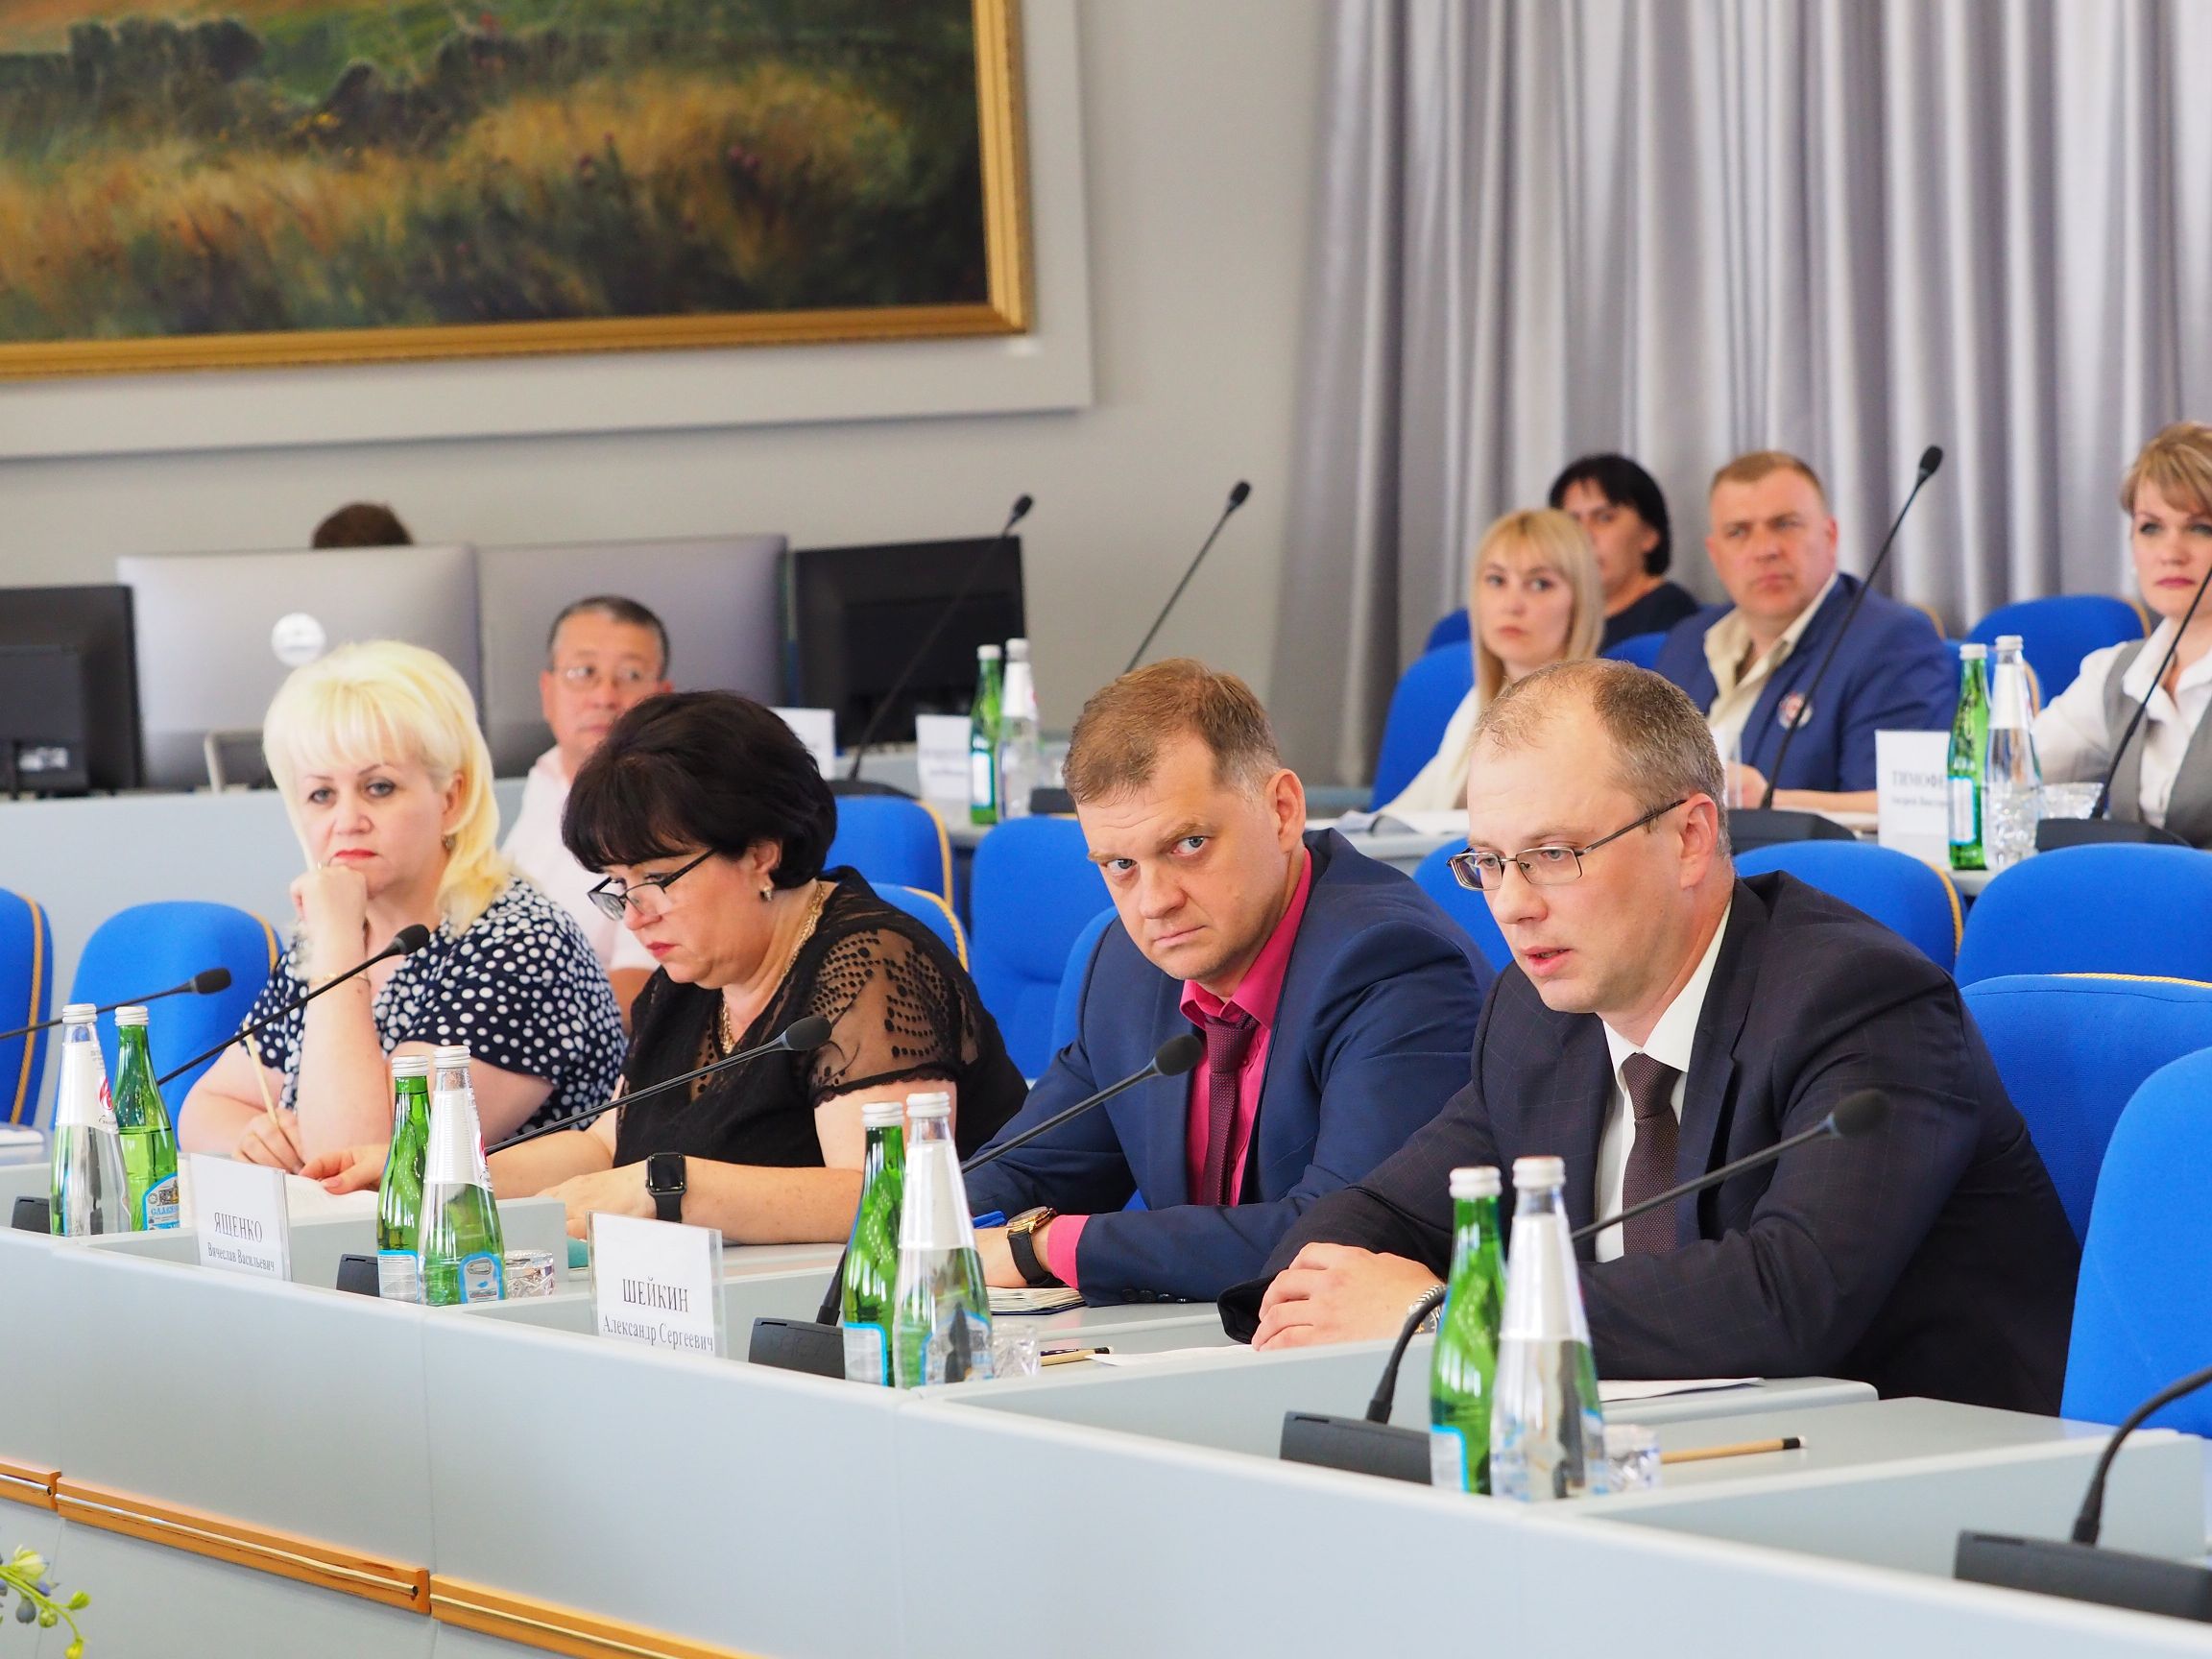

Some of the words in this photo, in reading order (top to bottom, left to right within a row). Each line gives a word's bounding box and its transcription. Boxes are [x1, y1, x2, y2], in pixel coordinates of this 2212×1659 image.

[214, 1212, 263, 1243] ЯЩЕНКО
[207, 1241, 237, 1262] Вячеслав
[237, 1249, 275, 1272] Васильевич
[622, 1275, 689, 1313] ШЕЙКИН
[603, 1314, 657, 1346] Александр
[659, 1322, 713, 1352] Сергеевич
